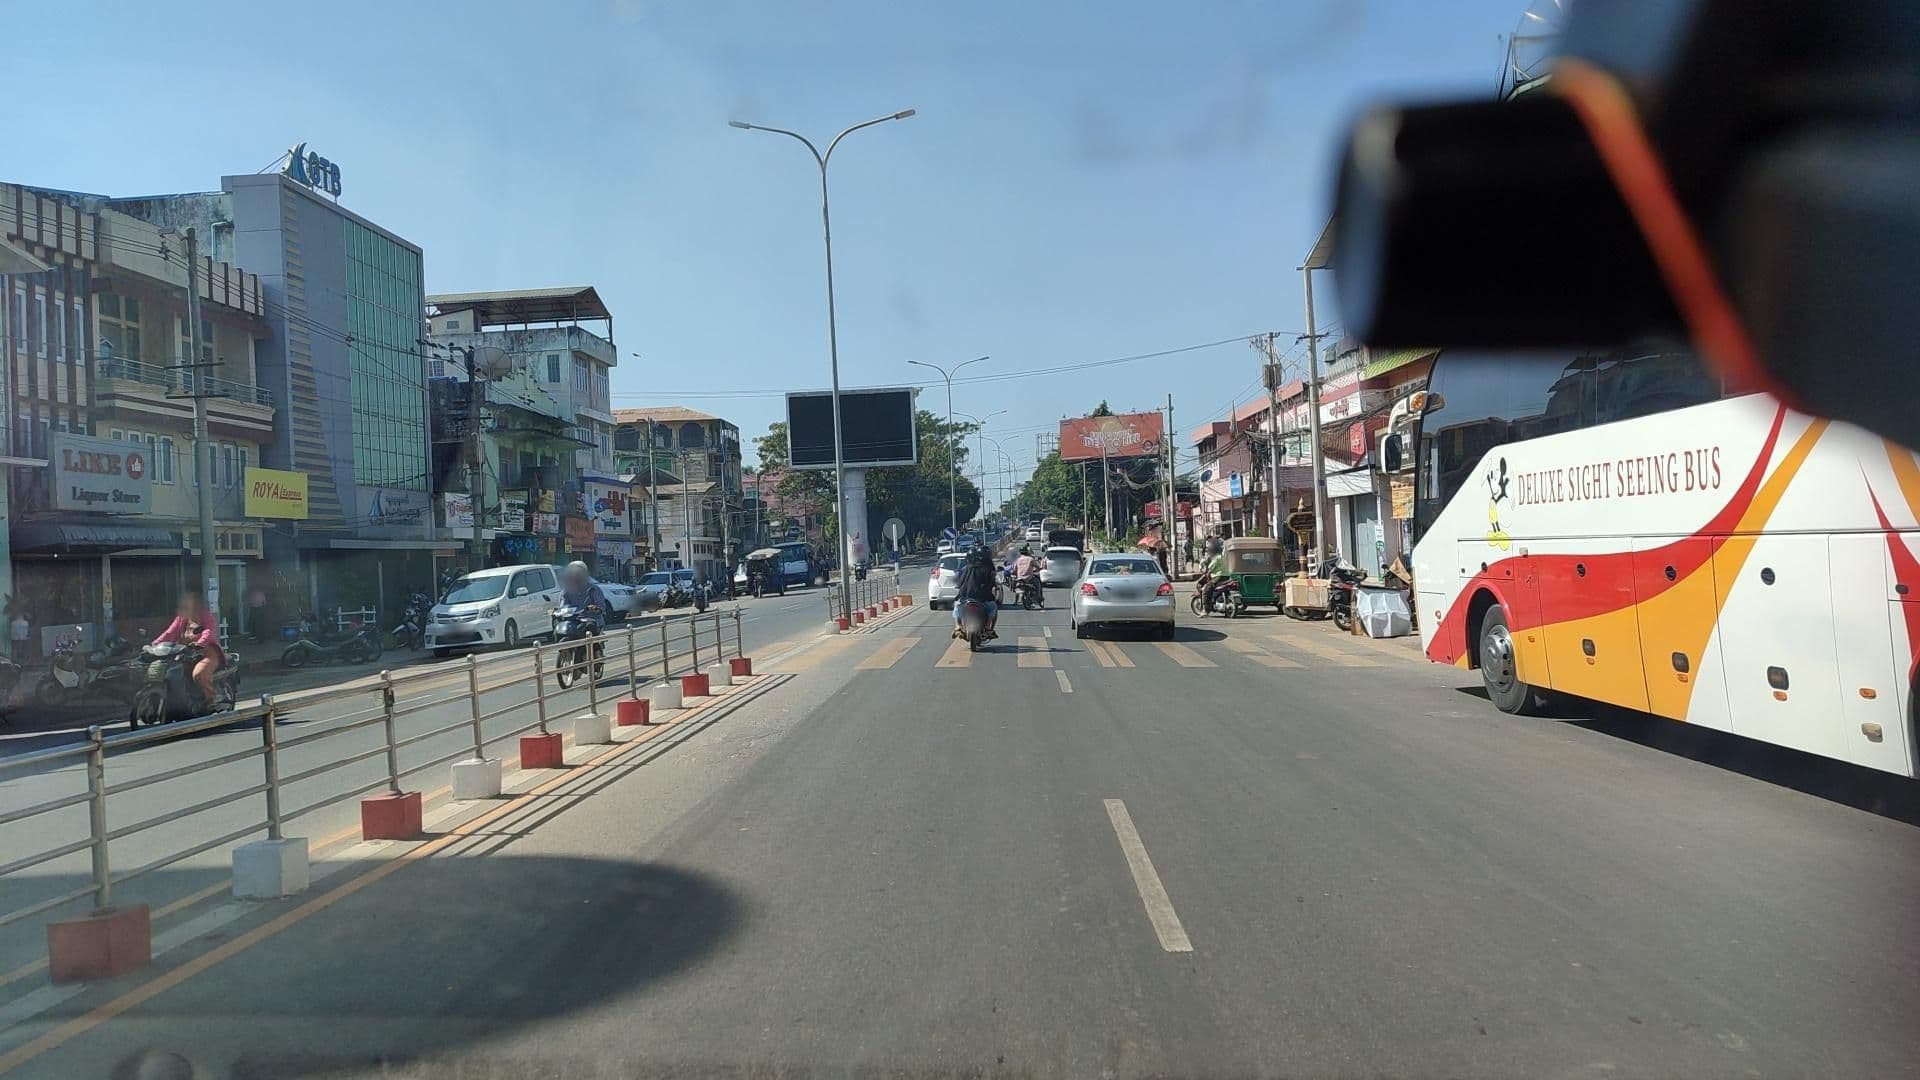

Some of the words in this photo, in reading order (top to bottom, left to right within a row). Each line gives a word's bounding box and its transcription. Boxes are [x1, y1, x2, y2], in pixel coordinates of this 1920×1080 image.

[63, 449, 121, 475] LIKE
[1518, 469, 1563, 505] DELUXE
[1568, 462, 1611, 501] SIGHT
[1617, 452, 1678, 497] SEEING
[1684, 446, 1721, 491] BUS
[112, 488, 141, 504] Store
